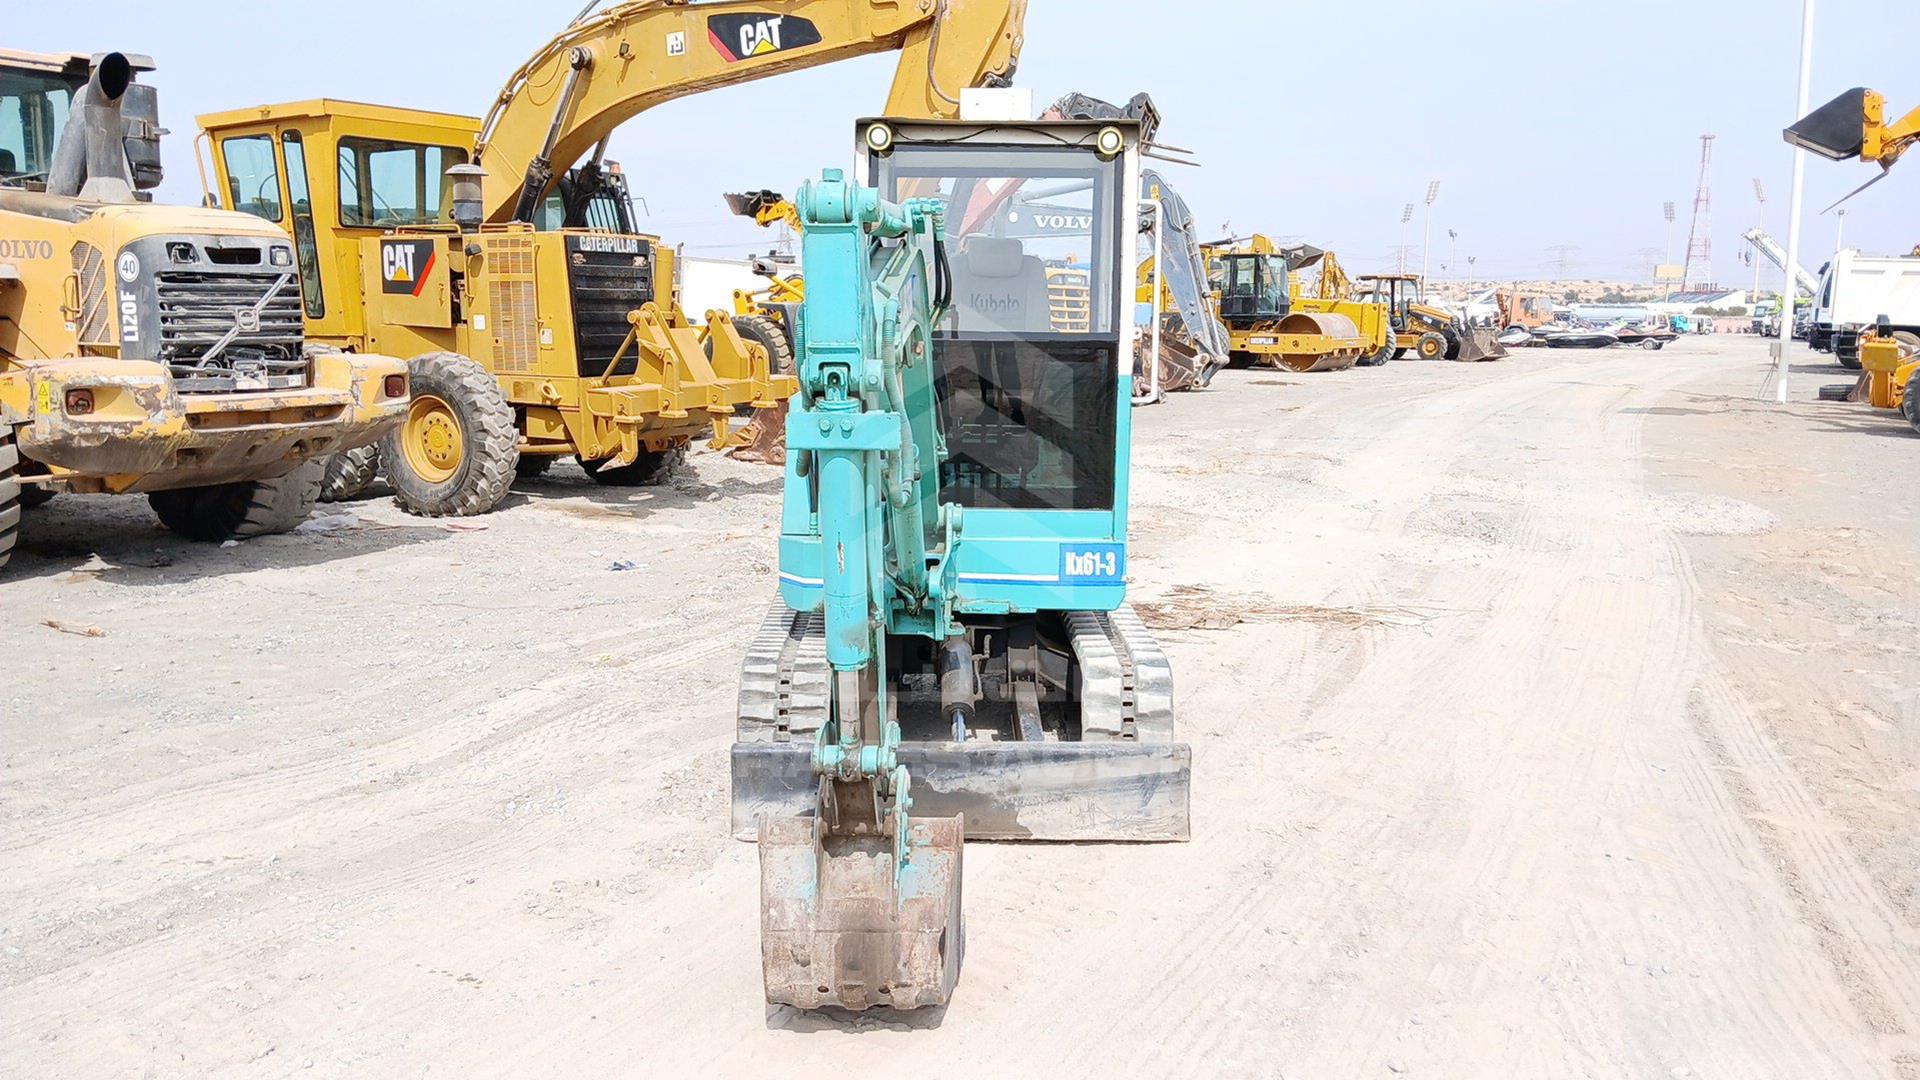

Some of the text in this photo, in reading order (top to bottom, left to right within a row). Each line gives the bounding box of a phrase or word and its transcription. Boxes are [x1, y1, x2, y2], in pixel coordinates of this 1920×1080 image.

[739, 18, 782, 56] CAT
[1033, 215, 1092, 229] VOLV
[0, 240, 53, 259] OLVO
[579, 236, 638, 253] CATERPILLAR
[122, 260, 136, 274] 40
[383, 244, 415, 282] CAT
[120, 290, 139, 342] L120F
